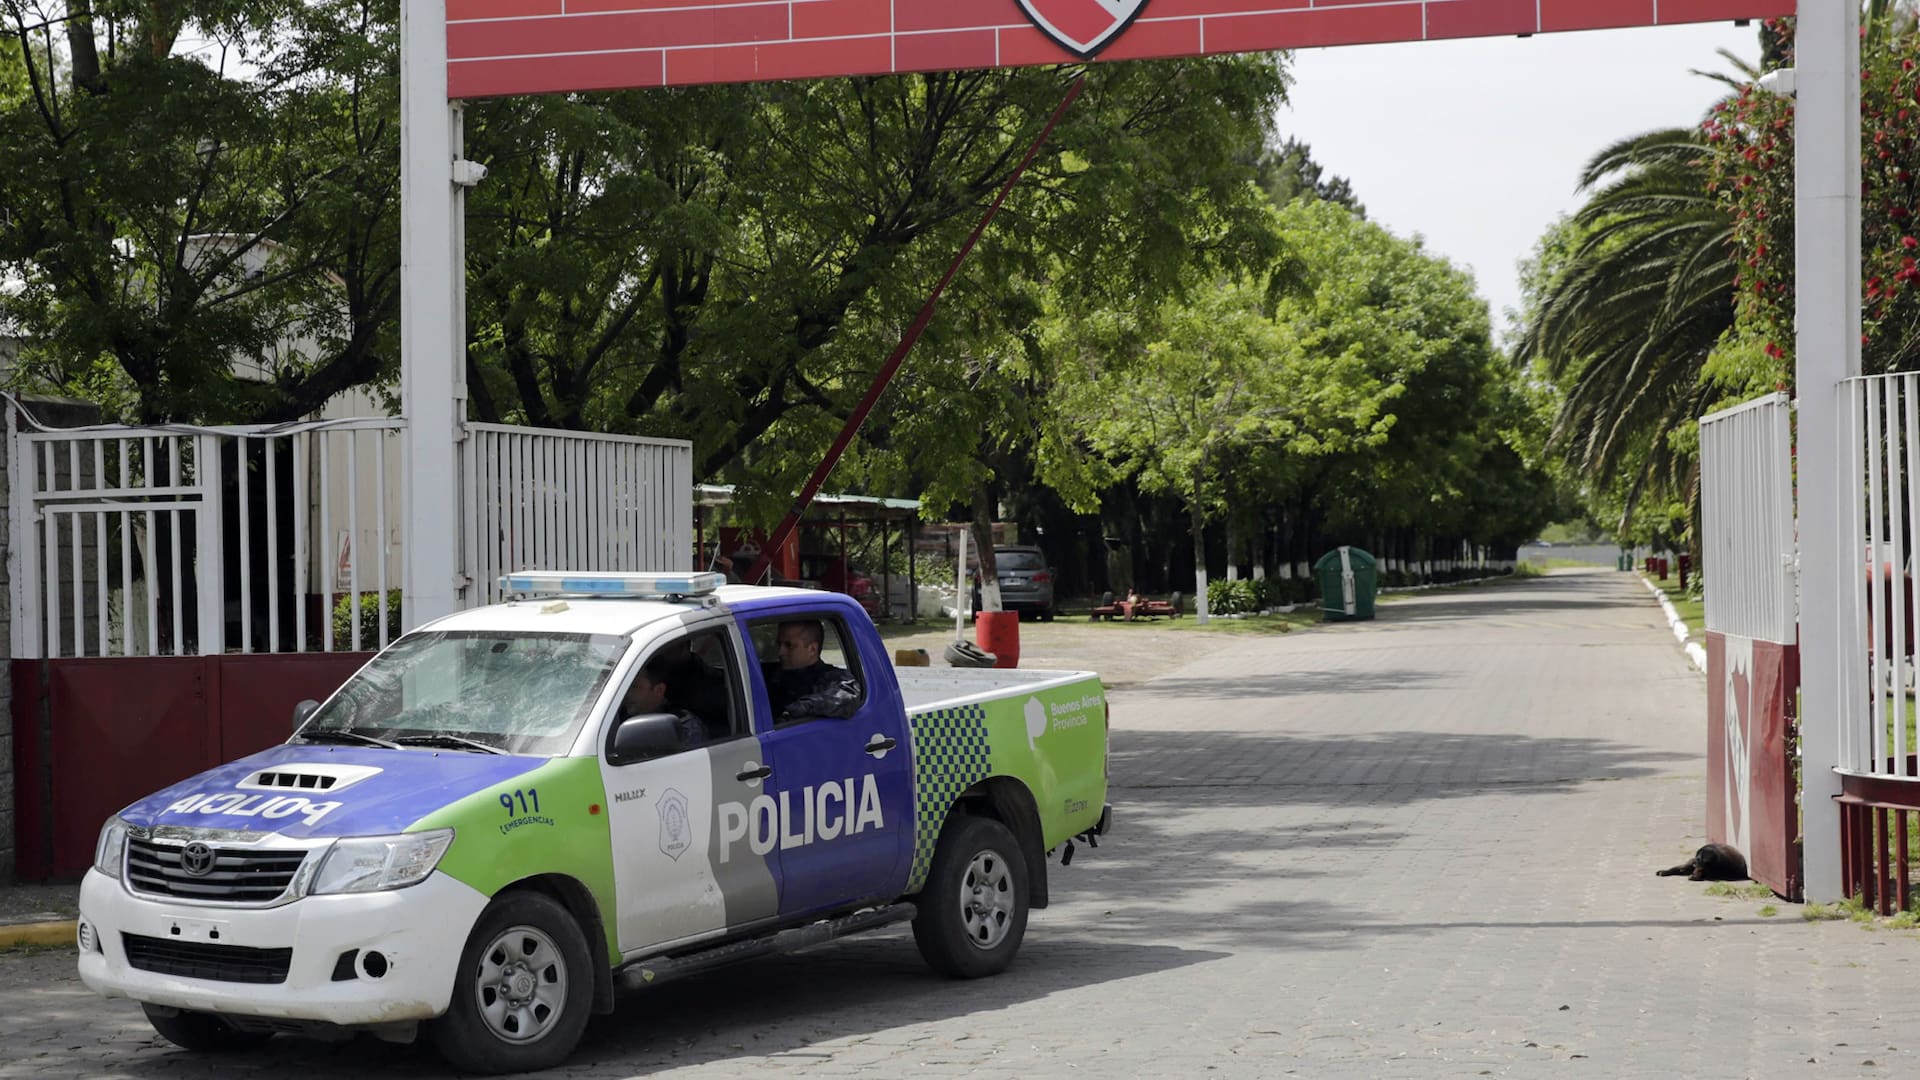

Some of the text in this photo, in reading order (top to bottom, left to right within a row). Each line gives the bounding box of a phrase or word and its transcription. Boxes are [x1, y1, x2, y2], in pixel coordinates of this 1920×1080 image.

[1050, 695, 1102, 716] Buenos Aires
[1053, 713, 1088, 731] Provincia
[499, 788, 540, 818] 911
[503, 816, 554, 832] EMERGENCIAS
[718, 773, 884, 864] POLICIA
